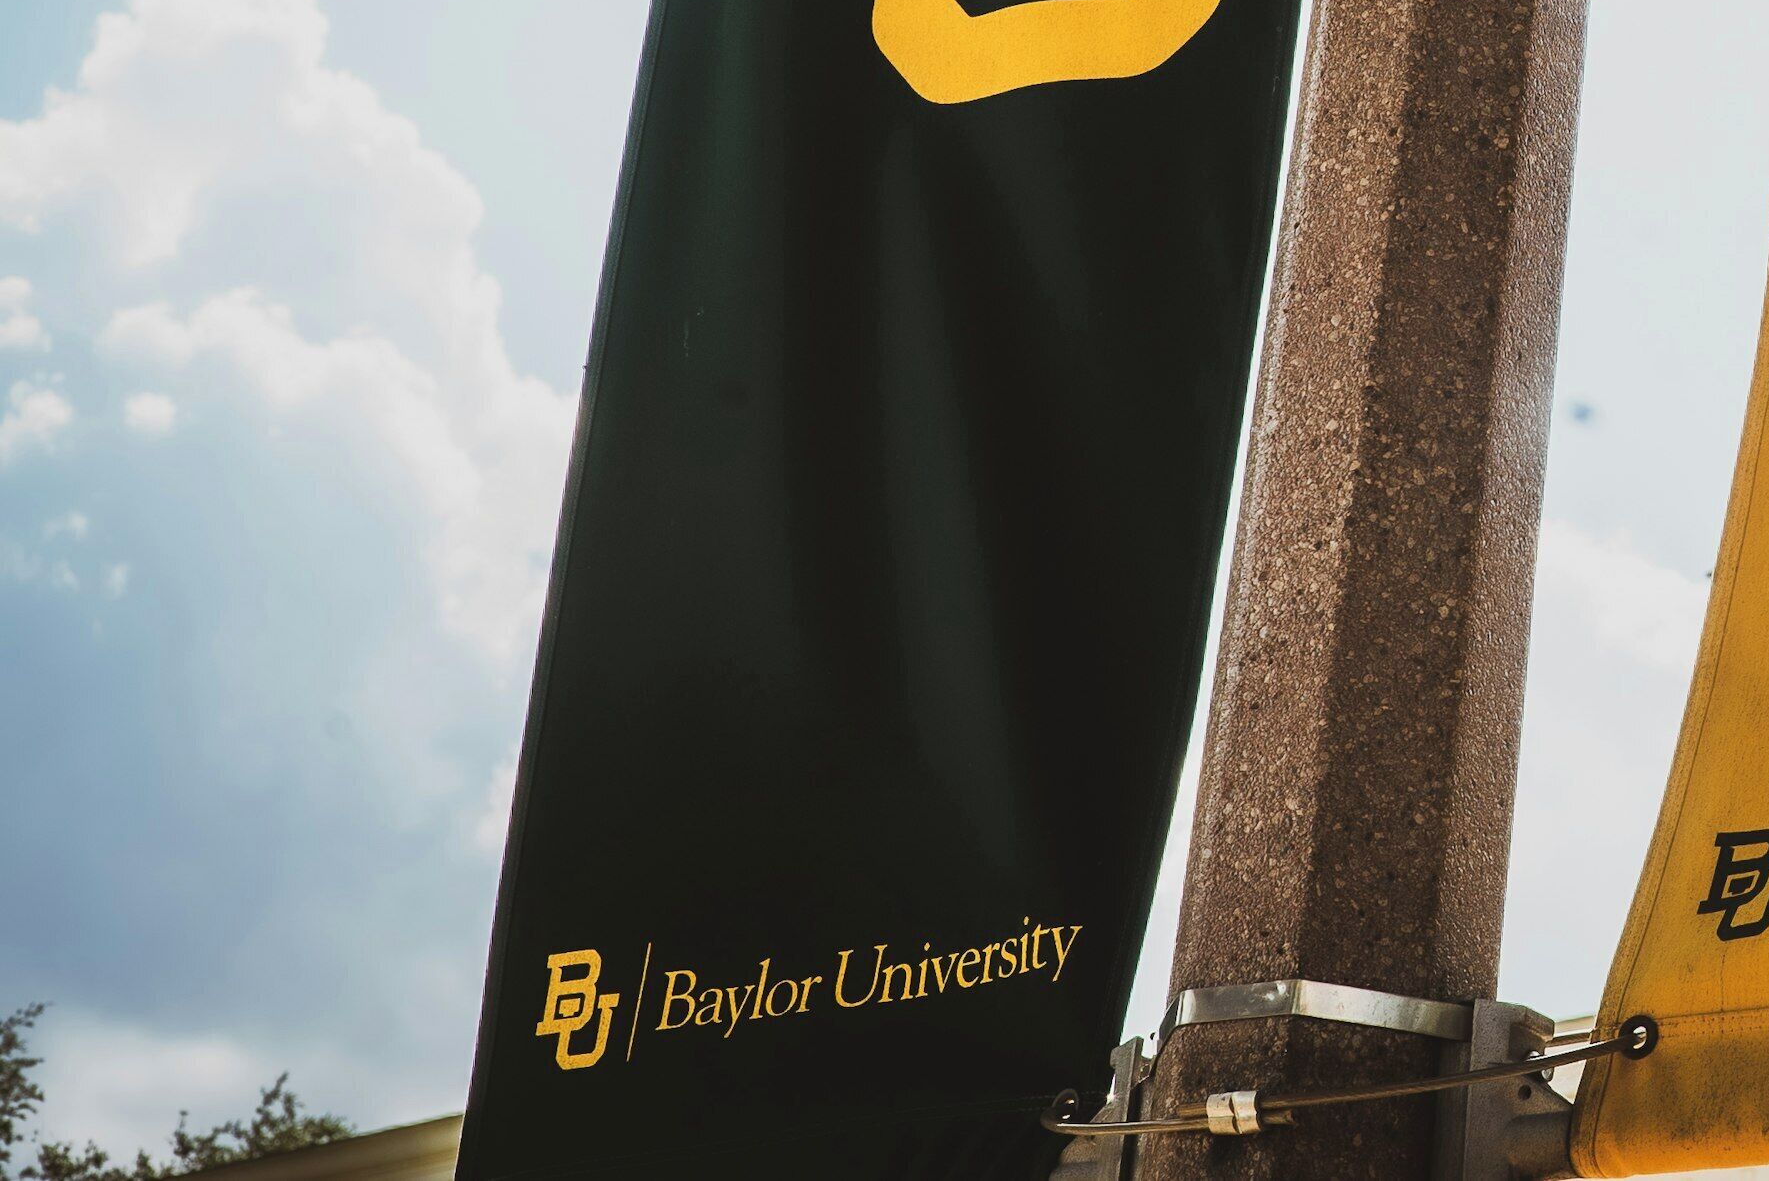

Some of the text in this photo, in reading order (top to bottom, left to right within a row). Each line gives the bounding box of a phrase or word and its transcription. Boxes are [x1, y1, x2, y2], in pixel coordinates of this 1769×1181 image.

[535, 916, 1083, 1070] BU Baylor University
